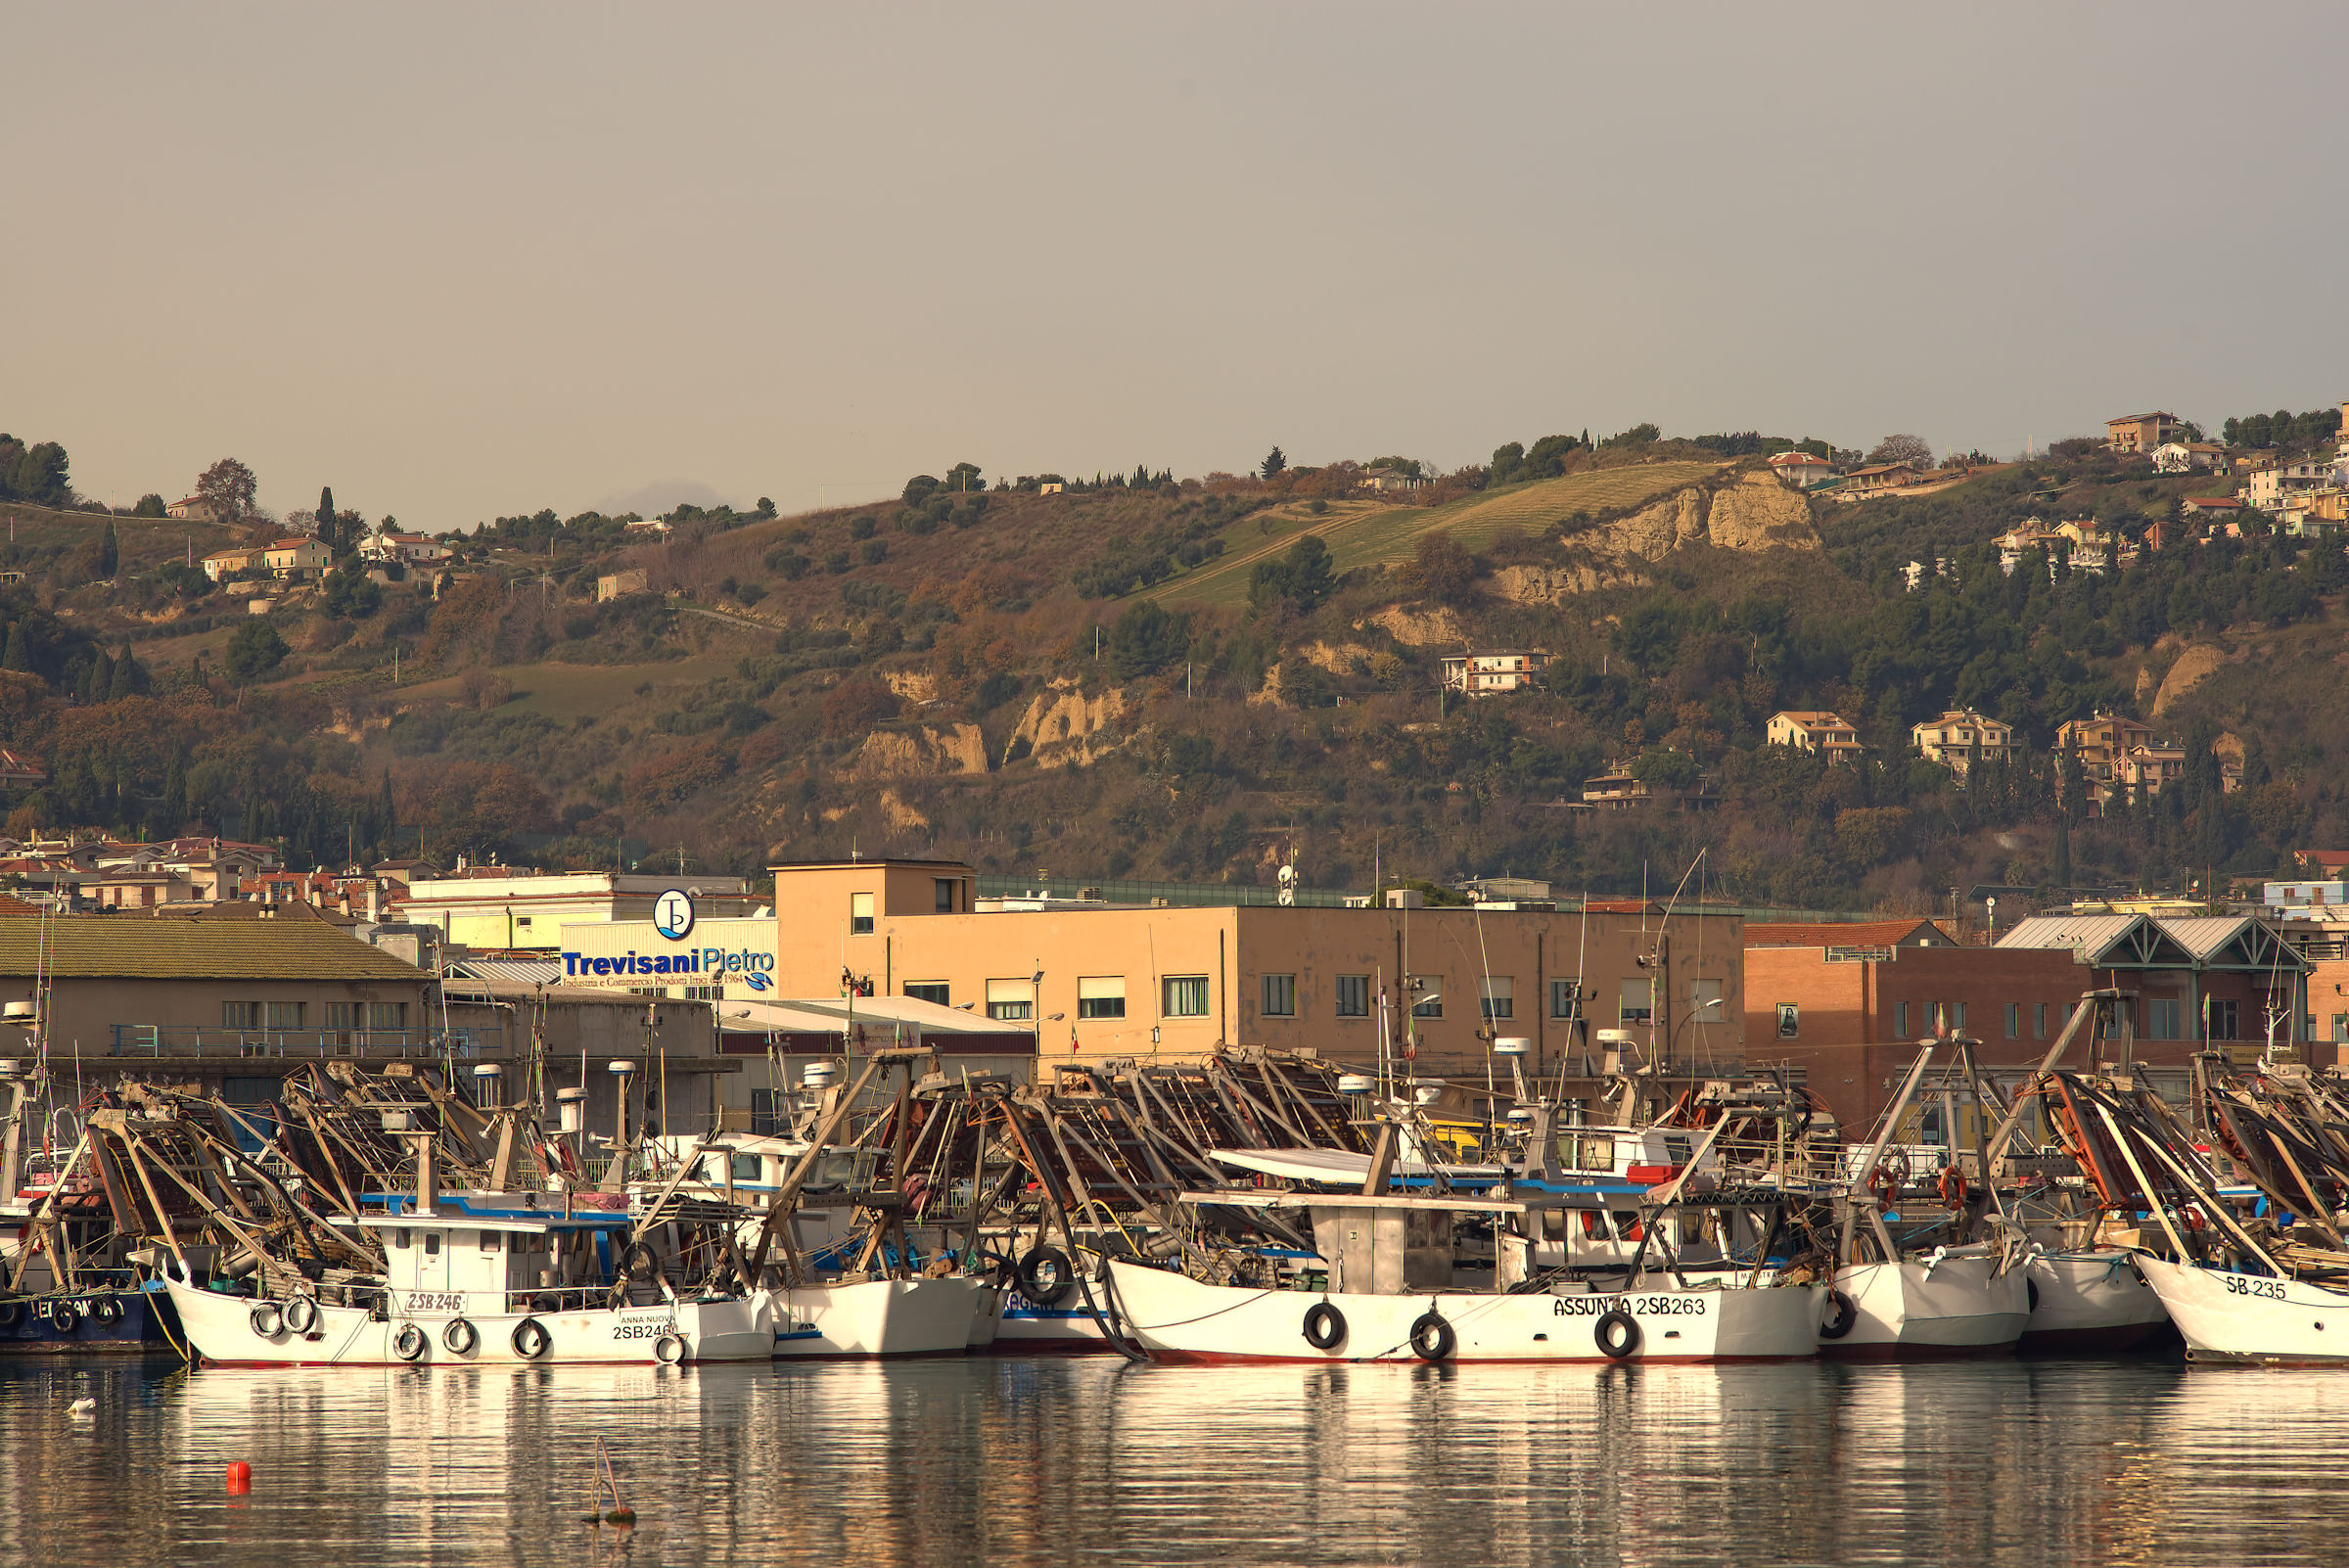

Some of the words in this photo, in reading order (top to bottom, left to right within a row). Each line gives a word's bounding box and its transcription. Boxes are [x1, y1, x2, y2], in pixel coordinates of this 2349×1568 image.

[561, 948, 699, 976] Trevisani
[702, 947, 775, 972] Pietro
[2227, 1275, 2248, 1295] SB
[2253, 1280, 2286, 1299] 235
[1636, 1297, 1706, 1315] 2SB263
